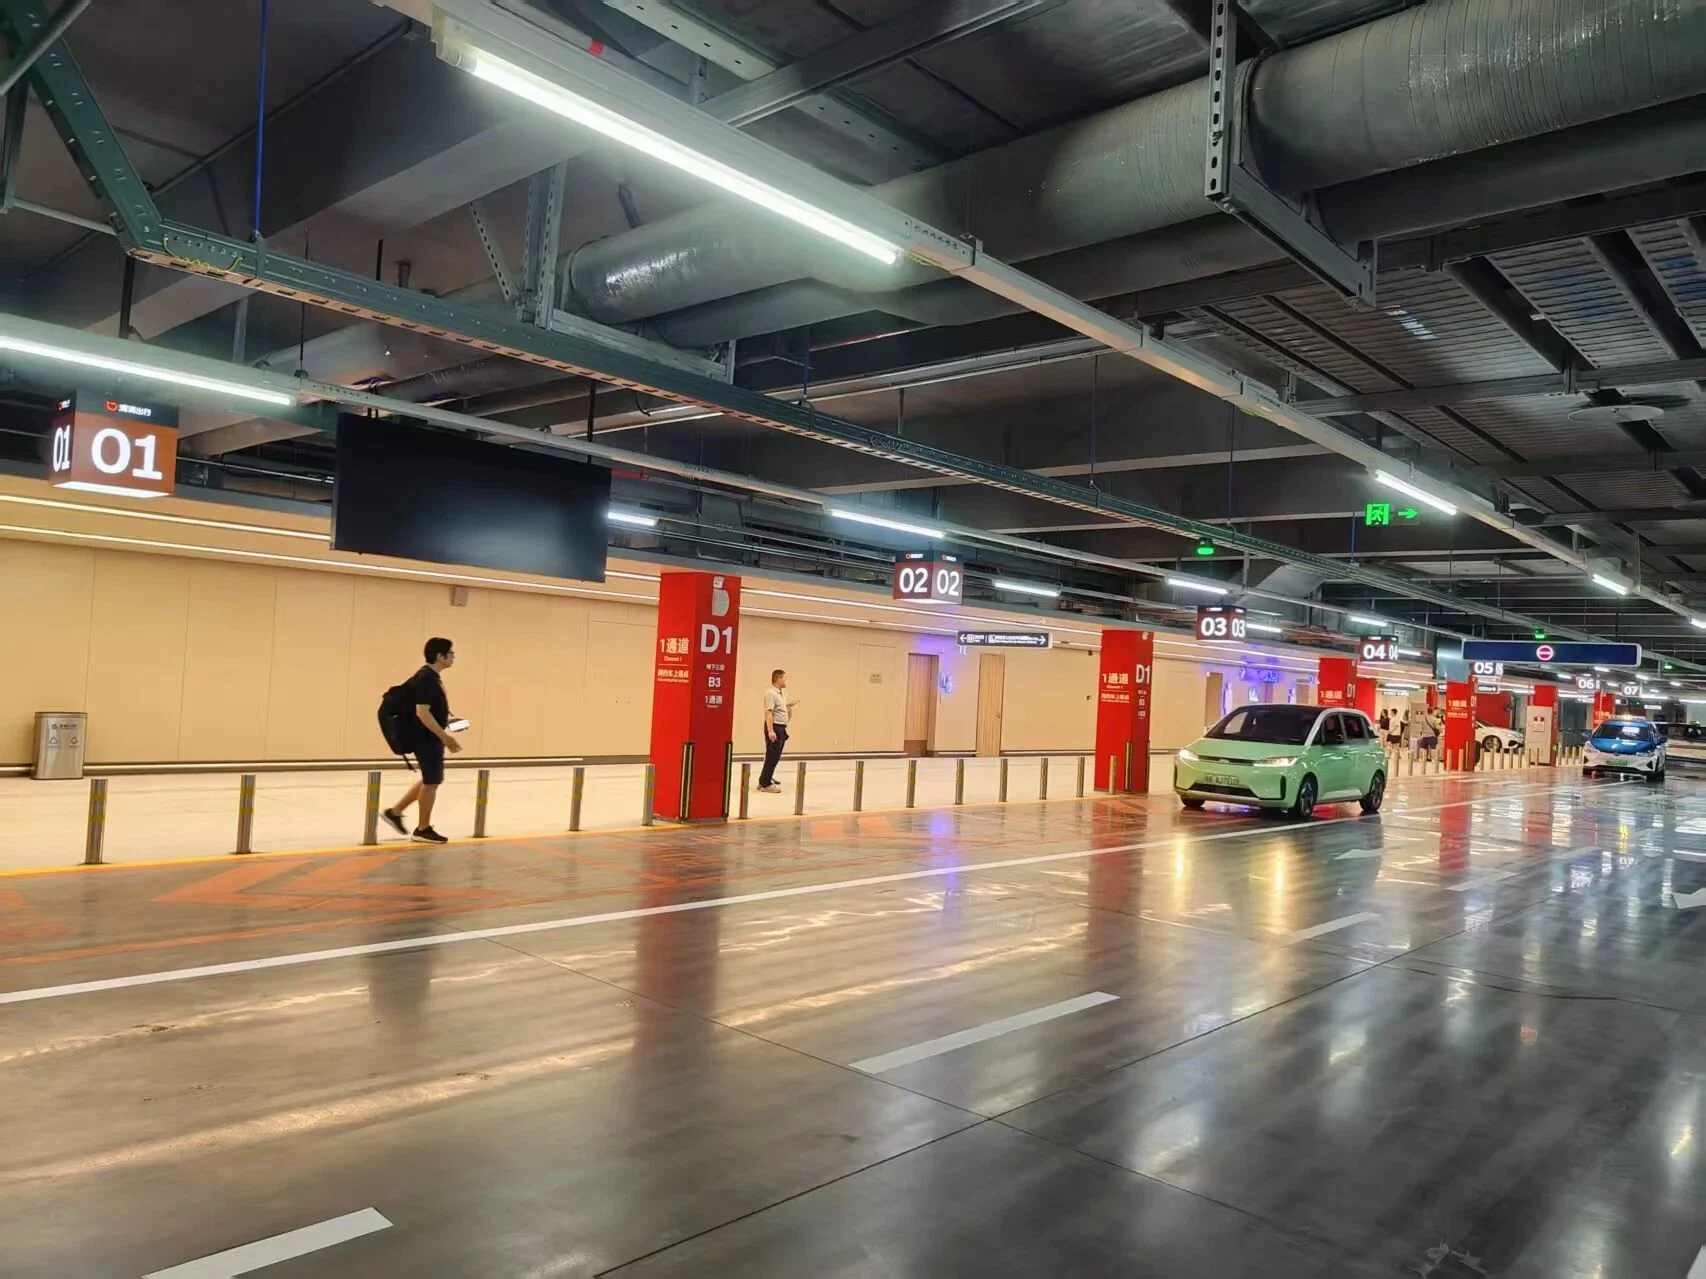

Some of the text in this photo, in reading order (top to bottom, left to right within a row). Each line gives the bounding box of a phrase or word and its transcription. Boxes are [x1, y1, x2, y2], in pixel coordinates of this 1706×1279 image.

[53, 424, 71, 473] 01
[91, 427, 163, 481] 01
[899, 567, 929, 593] 02
[936, 568, 960, 596] 02
[1200, 616, 1228, 637] 03
[1231, 617, 1246, 639] 03
[660, 637, 689, 654] 1通道
[700, 622, 733, 655] D1
[1363, 643, 1387, 660] 04
[1135, 663, 1151, 685] D1
[1474, 661, 1494, 674] 05
[707, 676, 721, 688] B3
[1578, 679, 1595, 690] 06
[1623, 685, 1639, 696] 07
